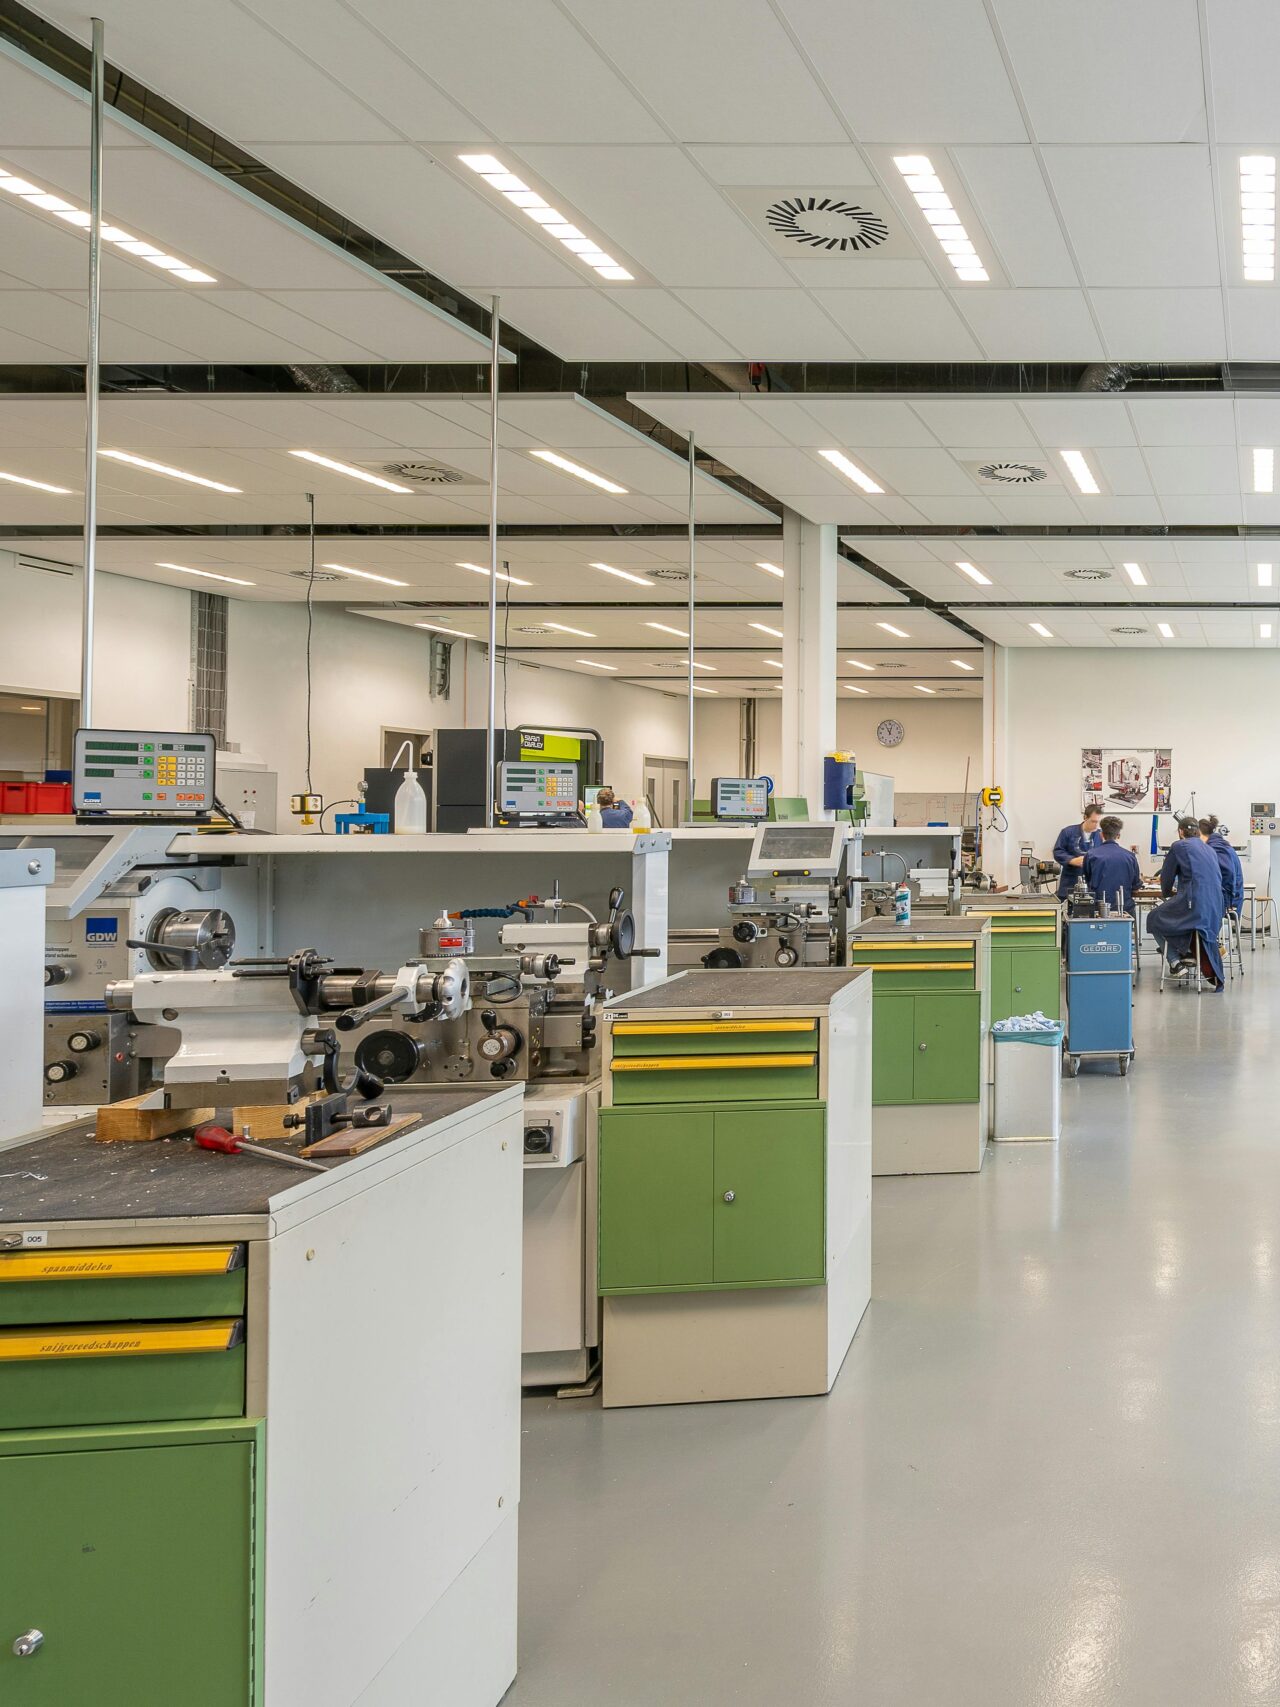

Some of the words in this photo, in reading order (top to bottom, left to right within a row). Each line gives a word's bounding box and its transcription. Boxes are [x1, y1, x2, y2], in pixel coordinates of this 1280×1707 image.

[86, 932, 117, 941] GDW
[41, 1262, 113, 1274] spanmiddelen
[40, 1340, 142, 1353] snijgereedschappen
